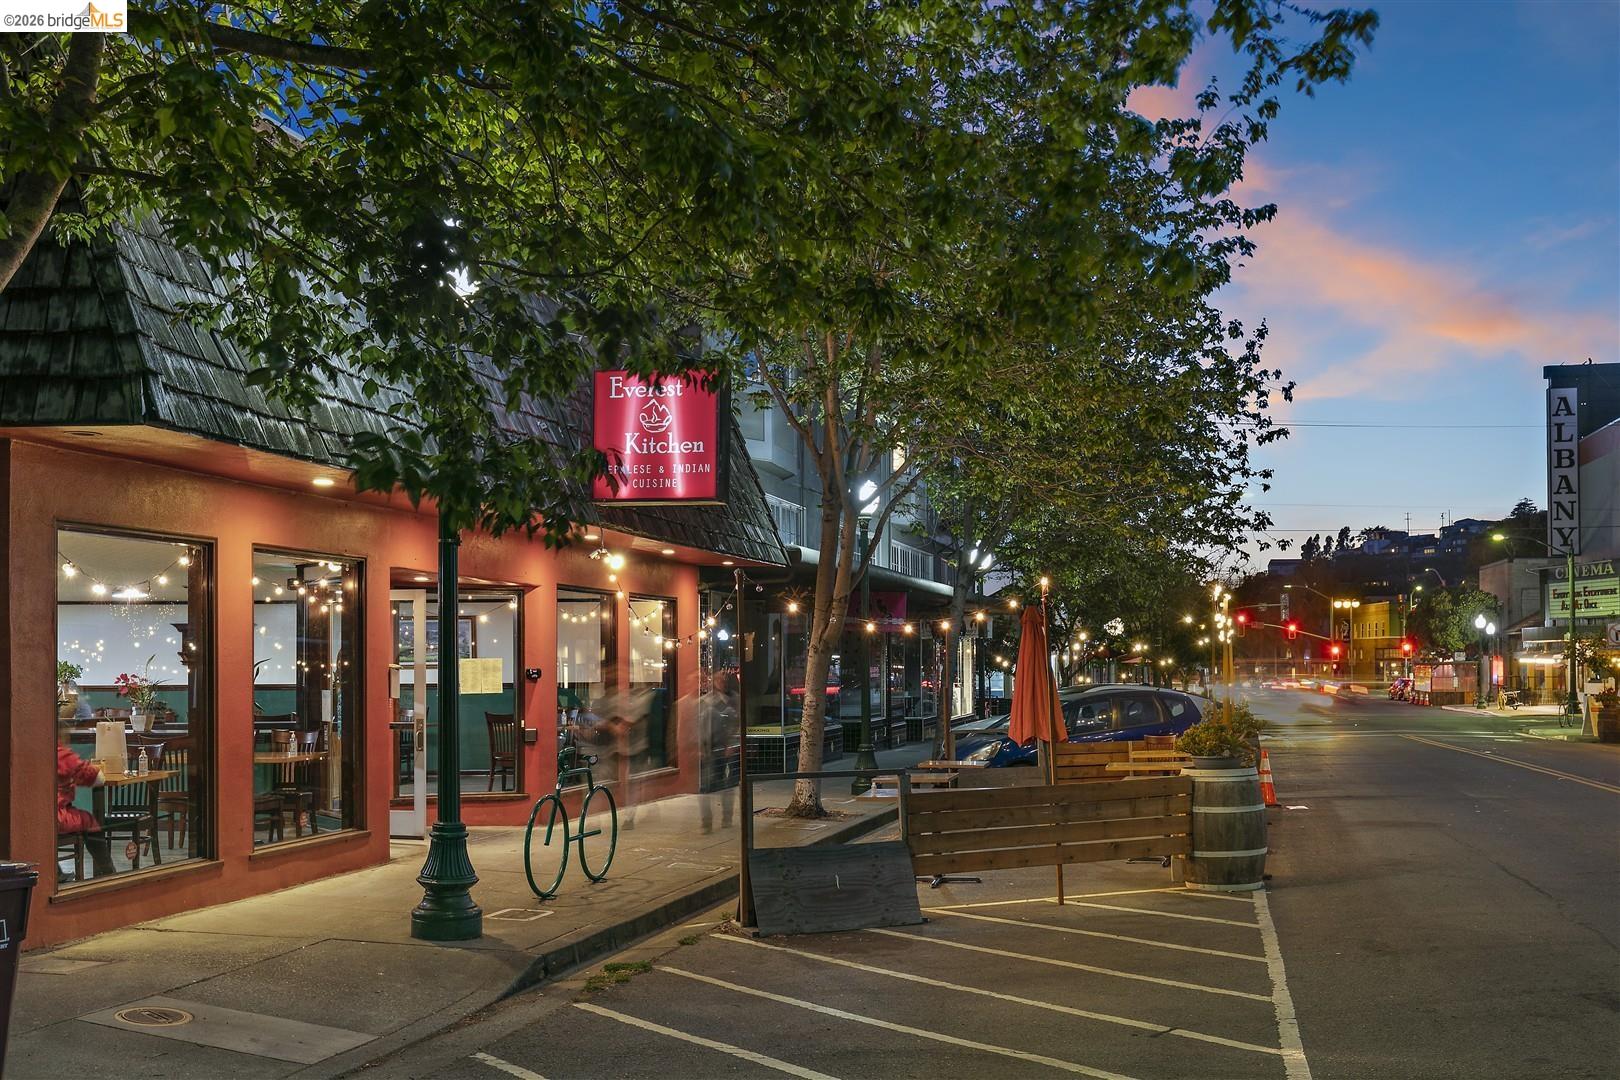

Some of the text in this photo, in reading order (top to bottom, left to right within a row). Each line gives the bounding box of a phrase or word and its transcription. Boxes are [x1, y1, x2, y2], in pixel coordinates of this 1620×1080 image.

[609, 376, 683, 399] Everest
[624, 432, 705, 455] Kitchen
[608, 463, 711, 475] EPALESE & INDIAN
[1551, 396, 1578, 547] ALBANY
[632, 478, 678, 489] CUISINE
